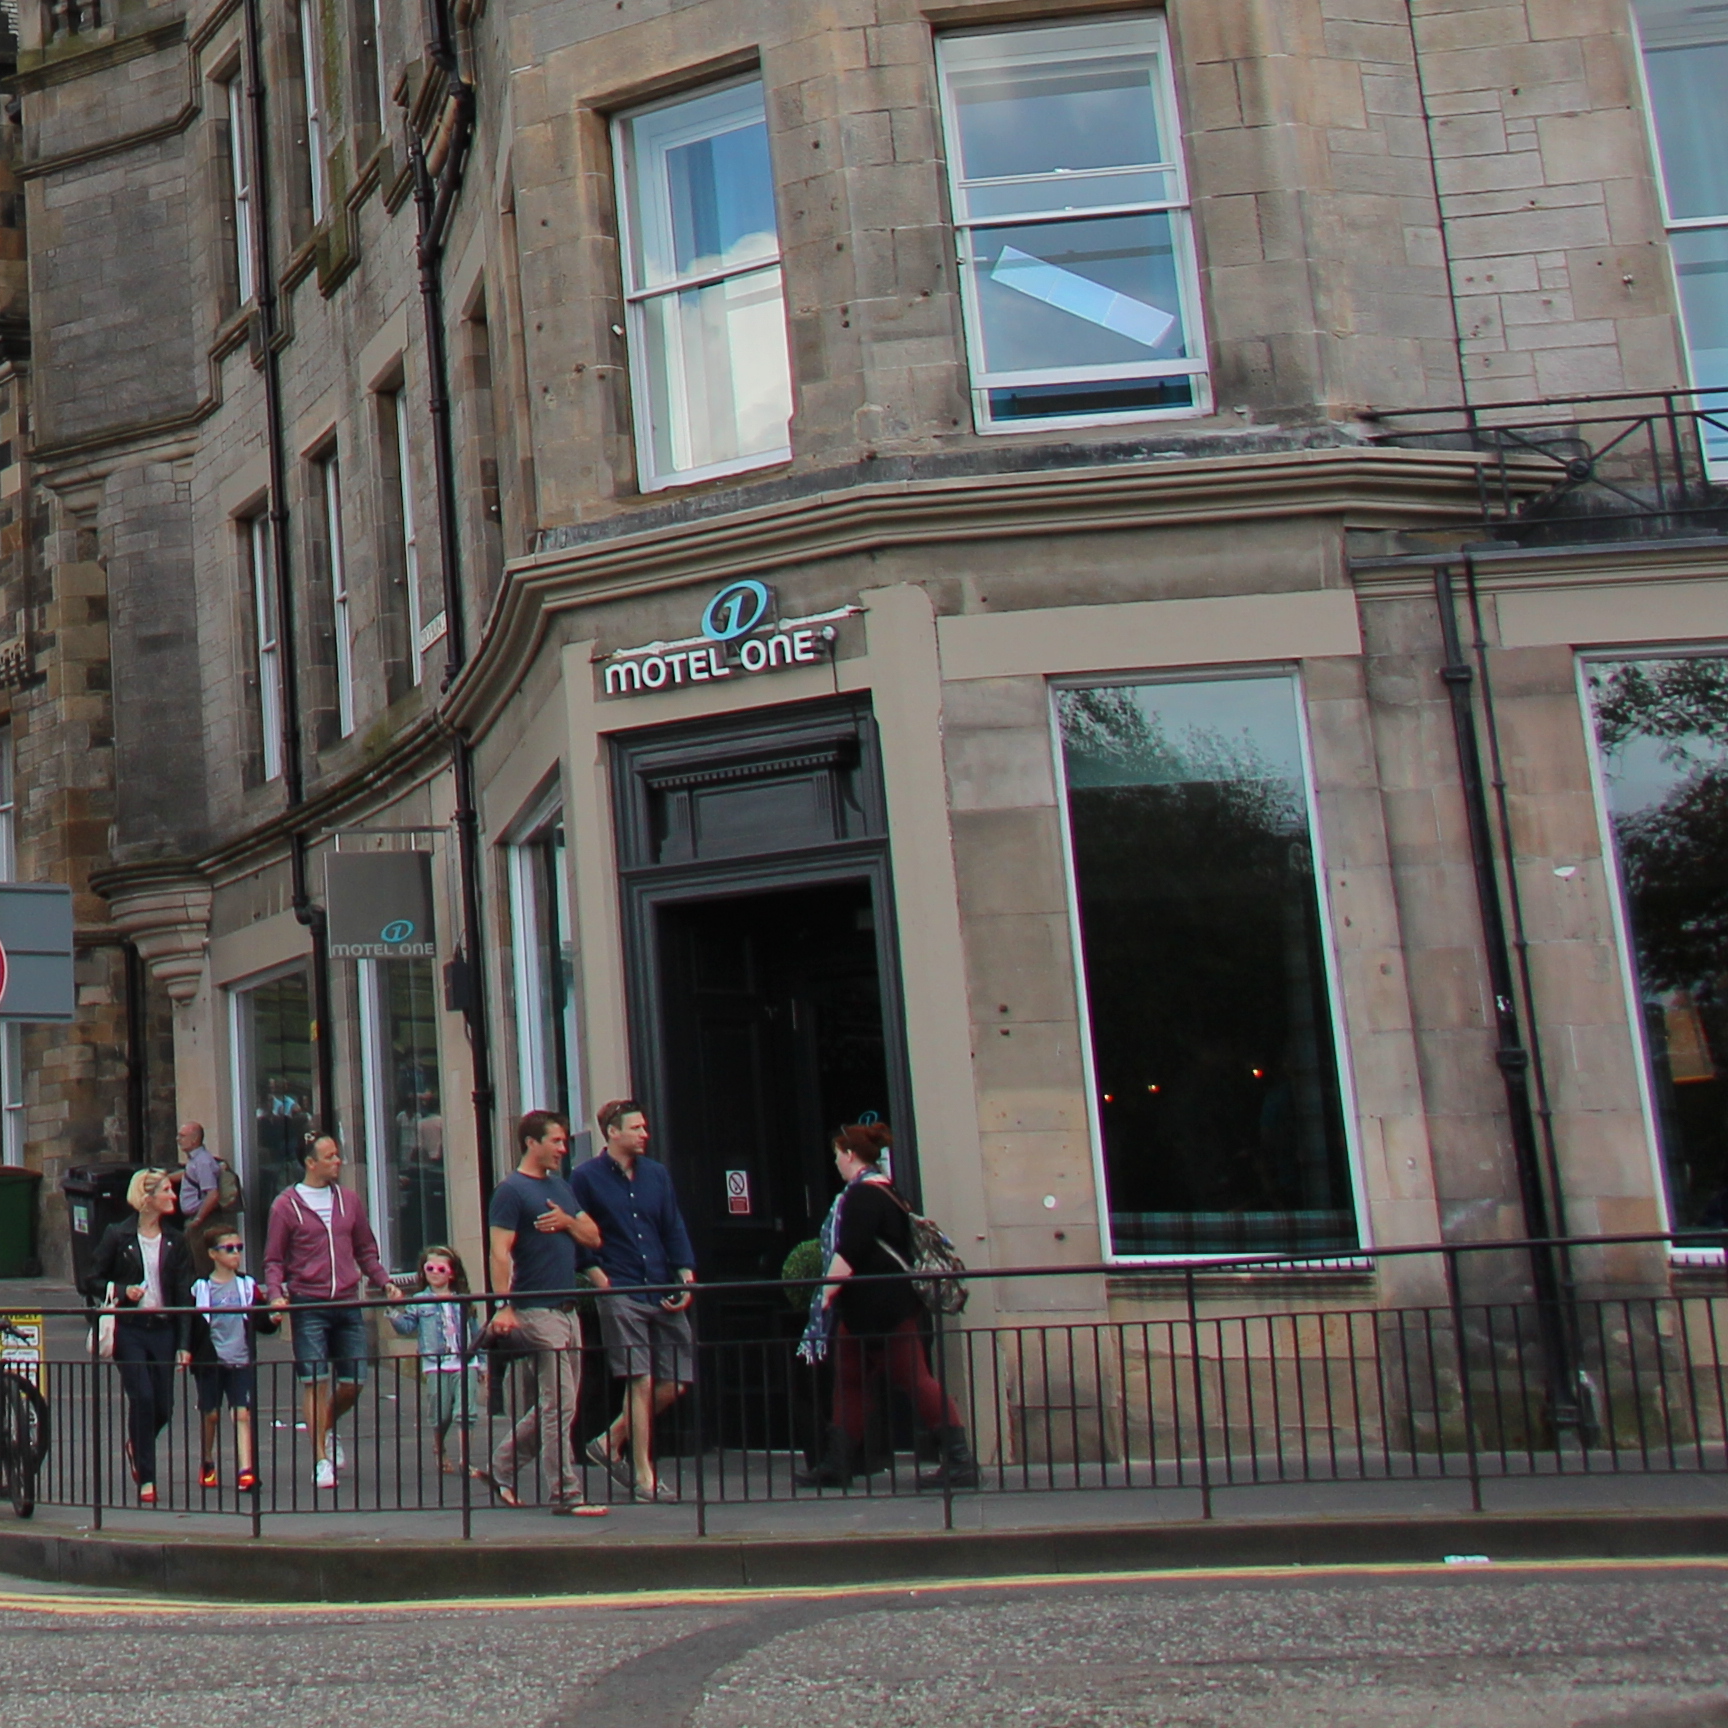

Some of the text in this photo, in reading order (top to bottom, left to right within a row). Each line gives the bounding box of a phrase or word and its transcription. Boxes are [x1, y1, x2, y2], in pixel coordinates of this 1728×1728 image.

[605, 630, 815, 694] MOTEL ONE
[332, 942, 434, 956] MOTEL ONE
